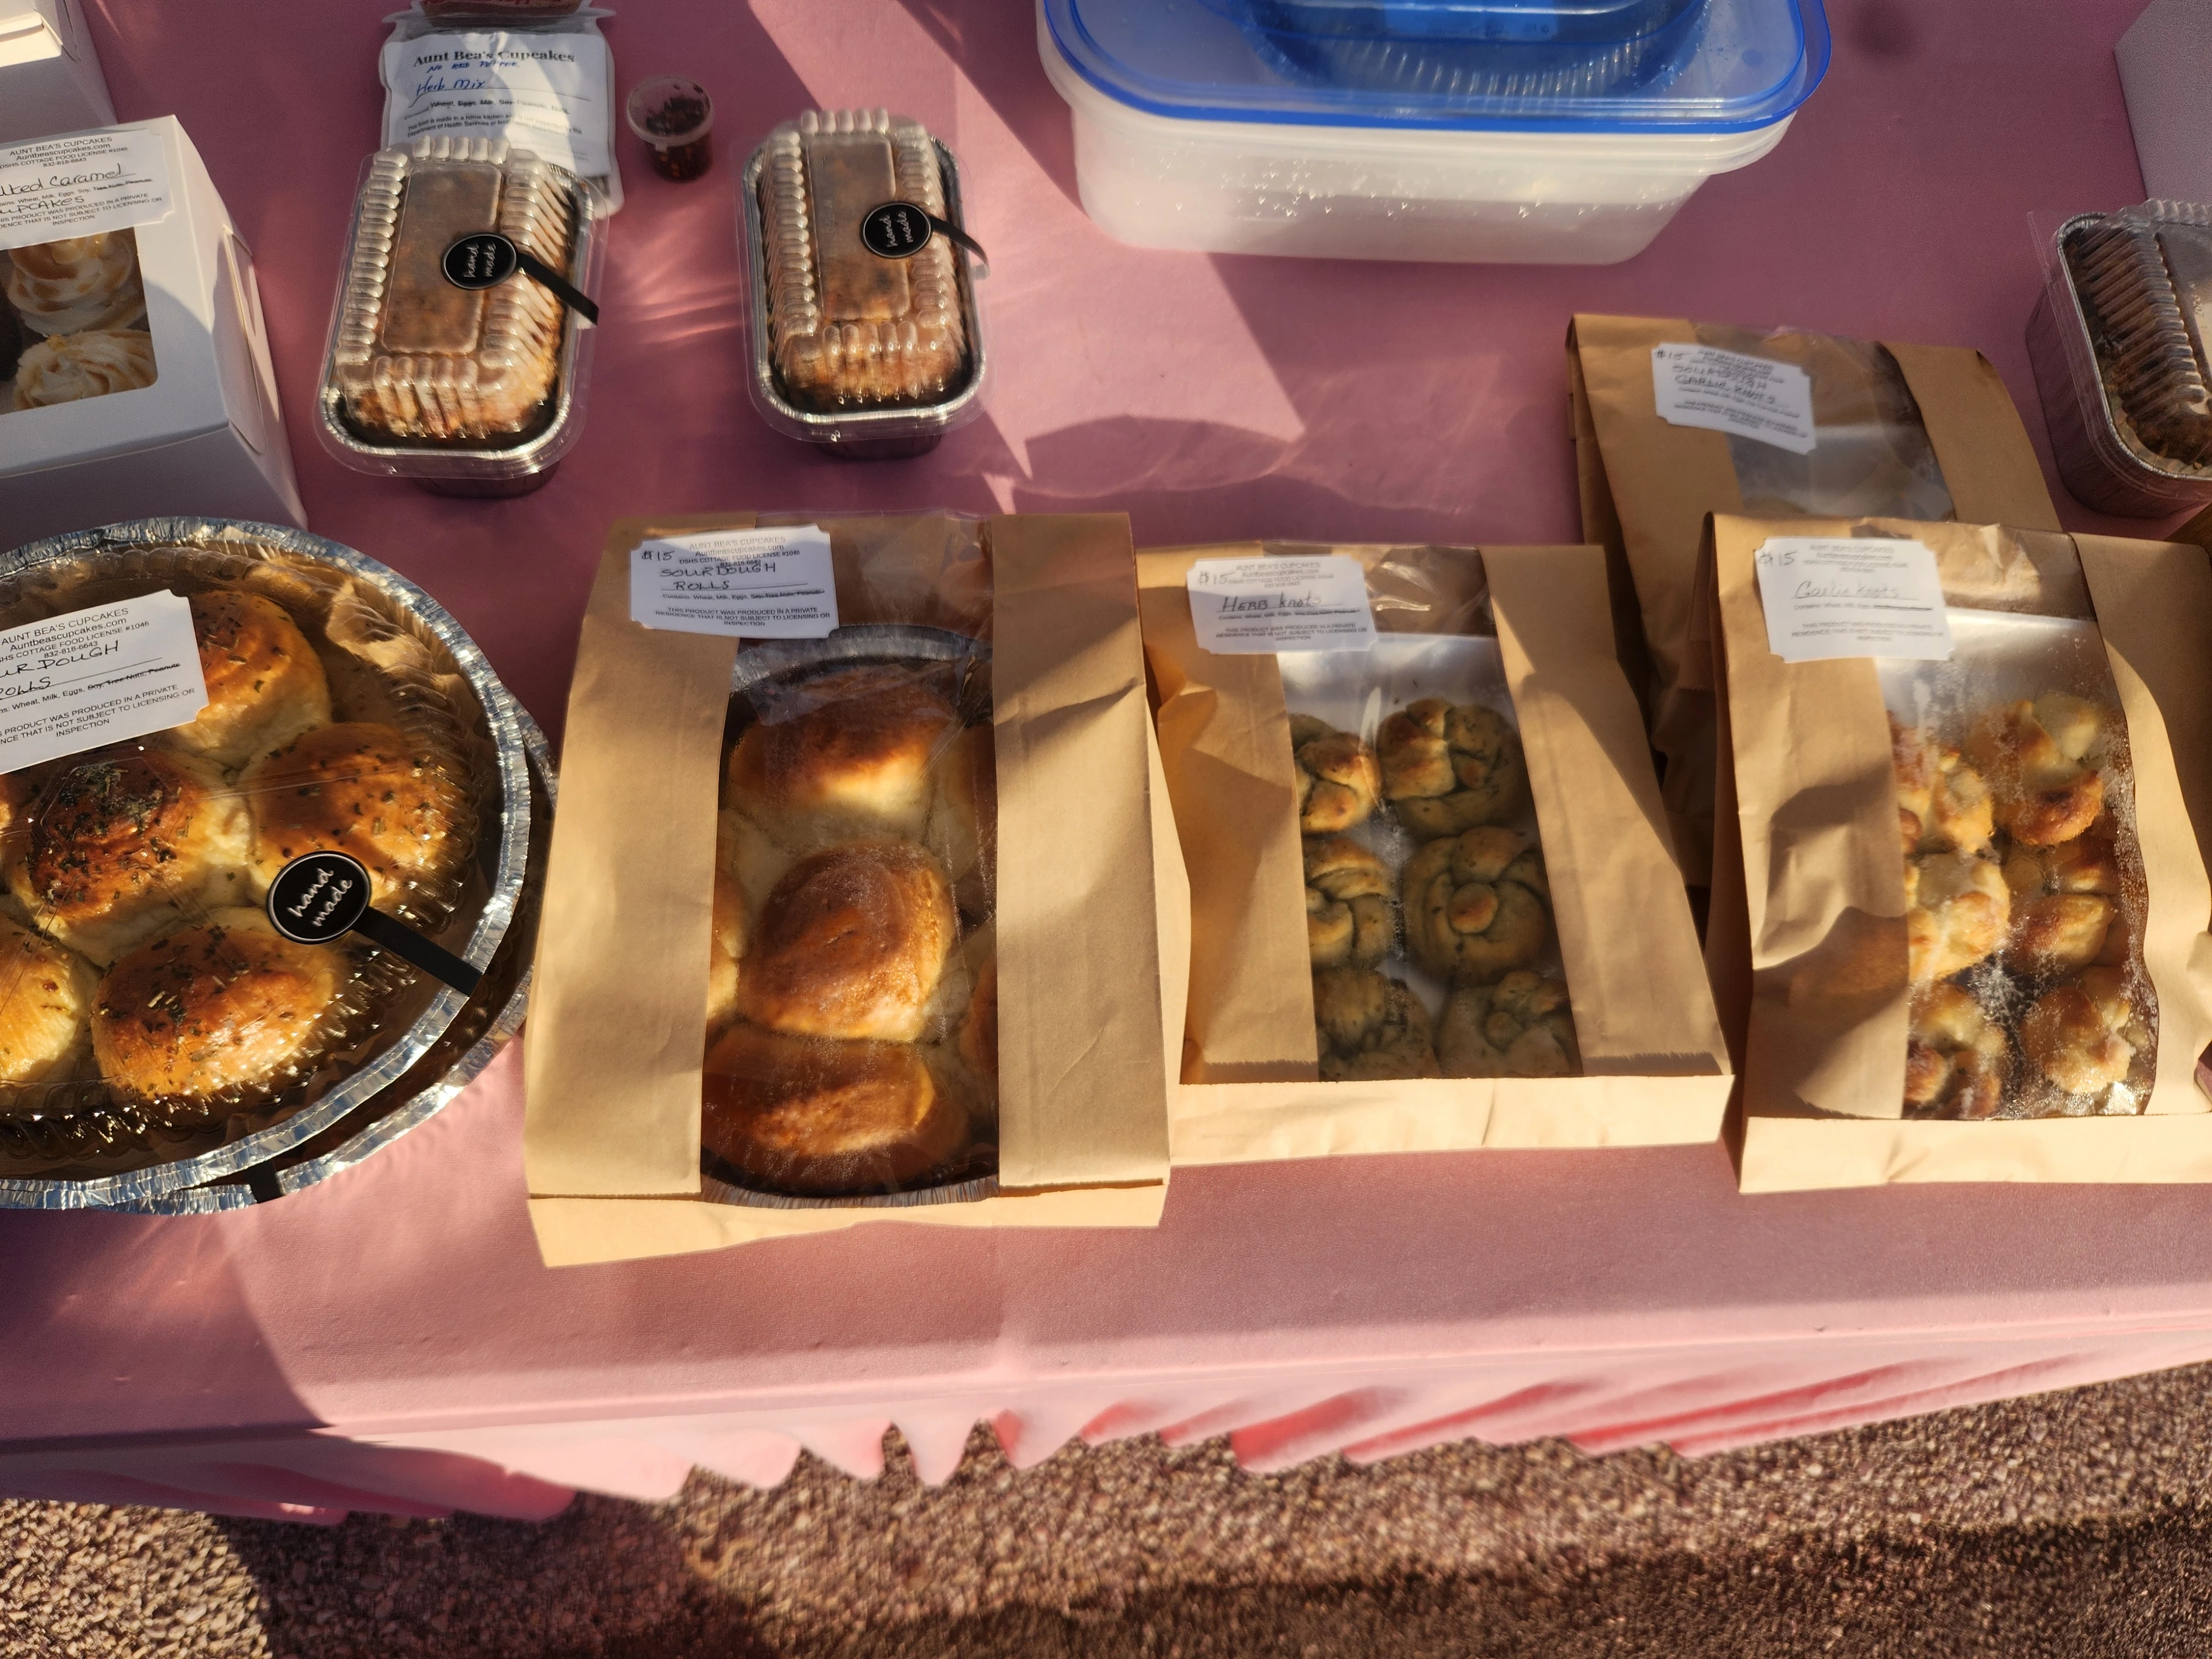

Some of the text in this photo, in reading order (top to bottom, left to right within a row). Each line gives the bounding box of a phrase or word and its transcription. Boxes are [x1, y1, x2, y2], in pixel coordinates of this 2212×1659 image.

[414, 49, 575, 67] Aunt Bea's Cupcakes
[416, 75, 486, 96] Herb Mix
[9, 137, 112, 156] AUNT BEA'S CUPCAKES
[16, 143, 111, 161] Auntbeascupcakes.com
[21, 157, 54, 165] COTTAGE
[0, 178, 43, 196] lted
[50, 163, 121, 186] Caramel
[12, 211, 45, 221] PRODUCT
[66, 201, 105, 212] PRODUCED
[121, 193, 149, 201] PRIVATE
[69, 207, 100, 216] SUBJECT
[113, 199, 150, 210] LICENSING
[53, 213, 95, 226] INSPECTION
[690, 536, 786, 550] AUNT BEA'S CUPCAKES
[695, 545, 784, 557] Auntbeascupcakes.com
[673, 581, 729, 590] ROLLS
[655, 611, 696, 619] RESIDENCE
[1, 608, 129, 646] AUNT BEA'S CUPCAKES
[10, 618, 127, 653] Auntbeascupcakes.com
[16, 644, 58, 658] COTTAGE
[60, 637, 84, 648] FOOD
[87, 627, 123, 640] LICENSE
[126, 620, 149, 631] #1046
[44, 640, 98, 658] 832-818-6643
[12, 698, 40, 709] Wheat,
[42, 693, 60, 702] Milk,
[62, 687, 85, 697] Eggs,
[5, 718, 48, 735] PRODUCT
[50, 712, 70, 722] WAS
[72, 699, 122, 716] PRODUCED
[143, 684, 179, 698] PRIVATE
[21, 727, 43, 739] THAT
[56, 719, 74, 729] NOT
[77, 708, 116, 723] SUBJECT
[133, 692, 180, 709] LICENSING
[56, 718, 110, 737] INSPECTION
[286, 867, 335, 918] hand
[311, 879, 353, 927] made
